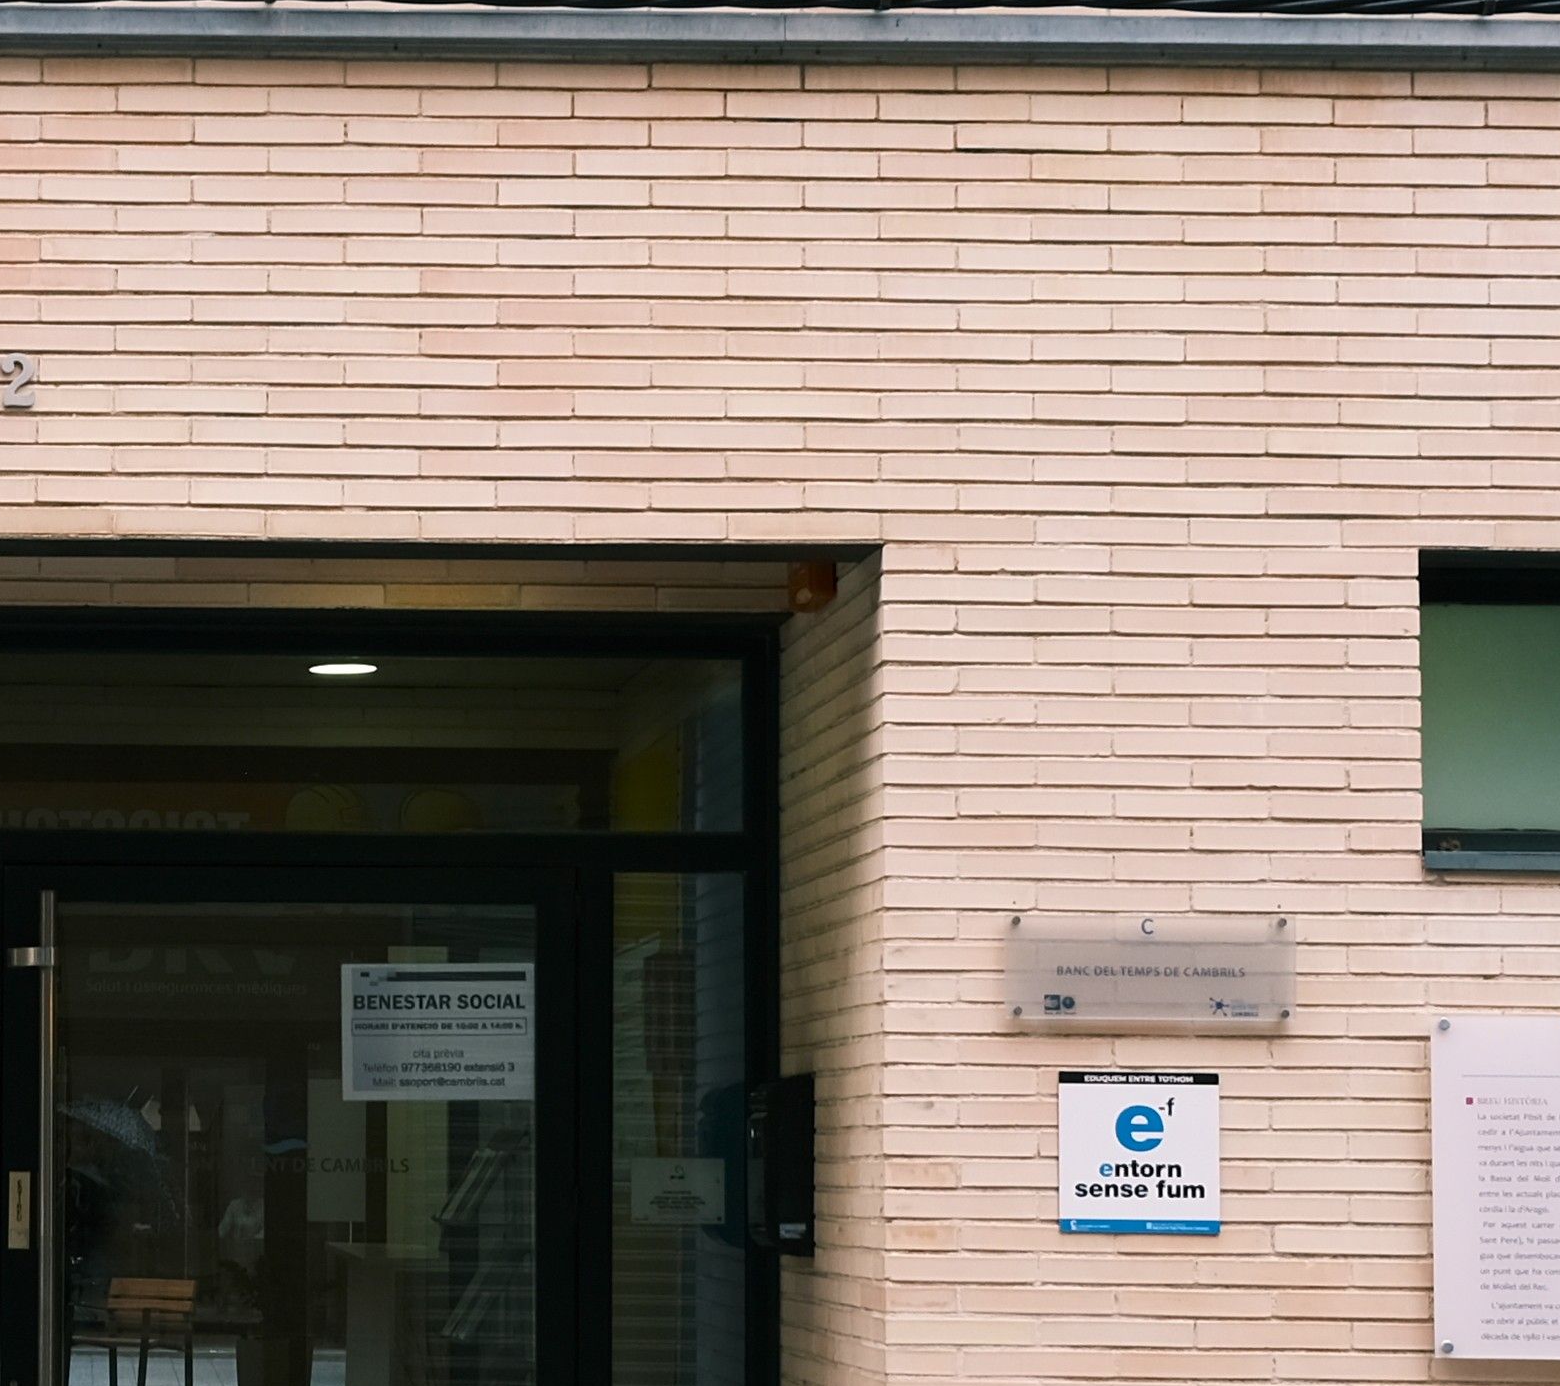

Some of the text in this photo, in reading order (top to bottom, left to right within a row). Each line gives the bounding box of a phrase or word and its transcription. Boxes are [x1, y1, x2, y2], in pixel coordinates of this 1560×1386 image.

[1141, 919, 1154, 934] C
[1056, 966, 1246, 978] BANC DEL TEMPS DE CAMBRILS
[353, 995, 525, 1010] BENESTAR SOCIAL
[413, 1048, 464, 1059] cita prèvia
[464, 1063, 505, 1072] extensió
[508, 1064, 514, 1072] 3
[1099, 1160, 1182, 1178] entorn
[1075, 1180, 1205, 1198] sense fum
